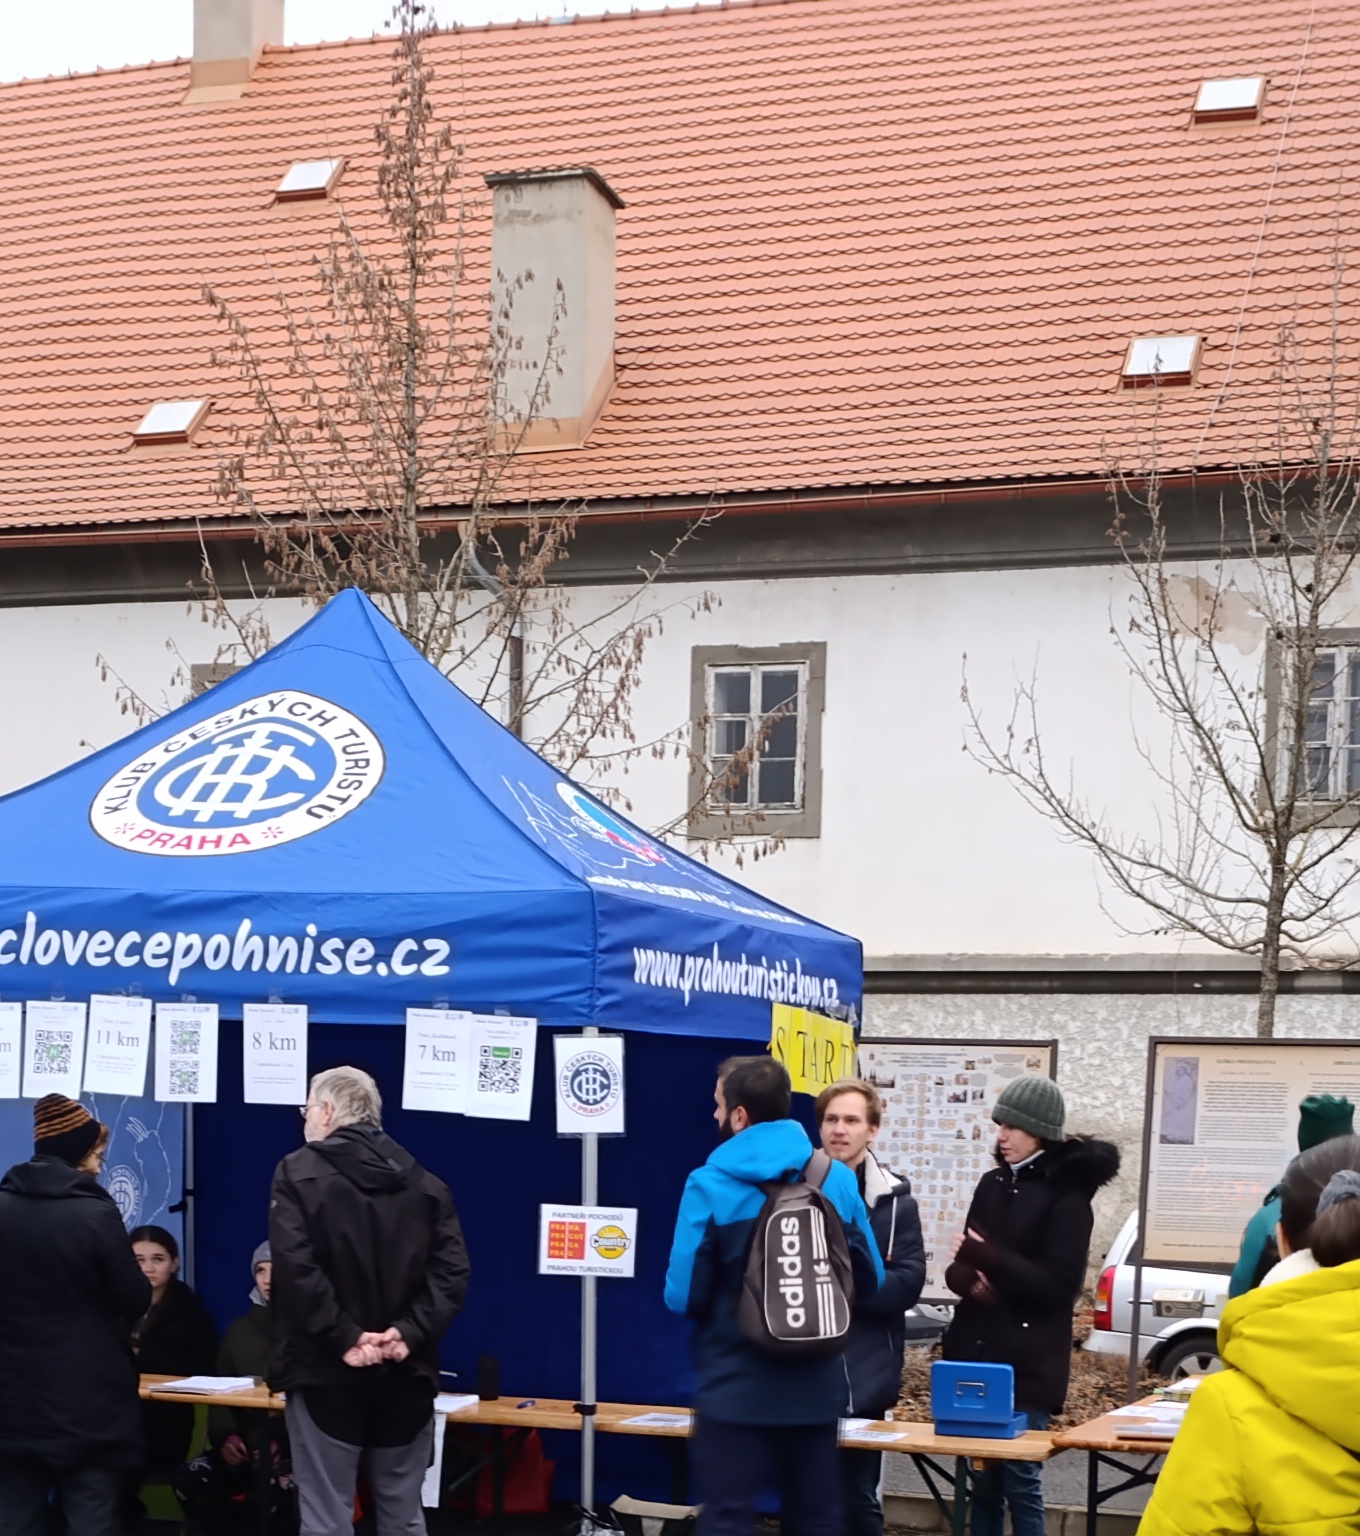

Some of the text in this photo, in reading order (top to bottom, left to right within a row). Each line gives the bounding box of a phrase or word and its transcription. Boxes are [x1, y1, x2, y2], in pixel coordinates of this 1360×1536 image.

[103, 760, 157, 815] KLUB
[163, 694, 338, 753] ČESKÝCH
[128, 828, 252, 851] PRAHA
[633, 941, 840, 1007] www.prahouturistickou.cz
[97, 1030, 140, 1048] 11 km
[252, 1031, 297, 1051] 8 km
[418, 1044, 456, 1062] 7 km
[776, 1026, 850, 1084] START
[590, 1234, 631, 1250] Country
[777, 1216, 806, 1328] adidas
